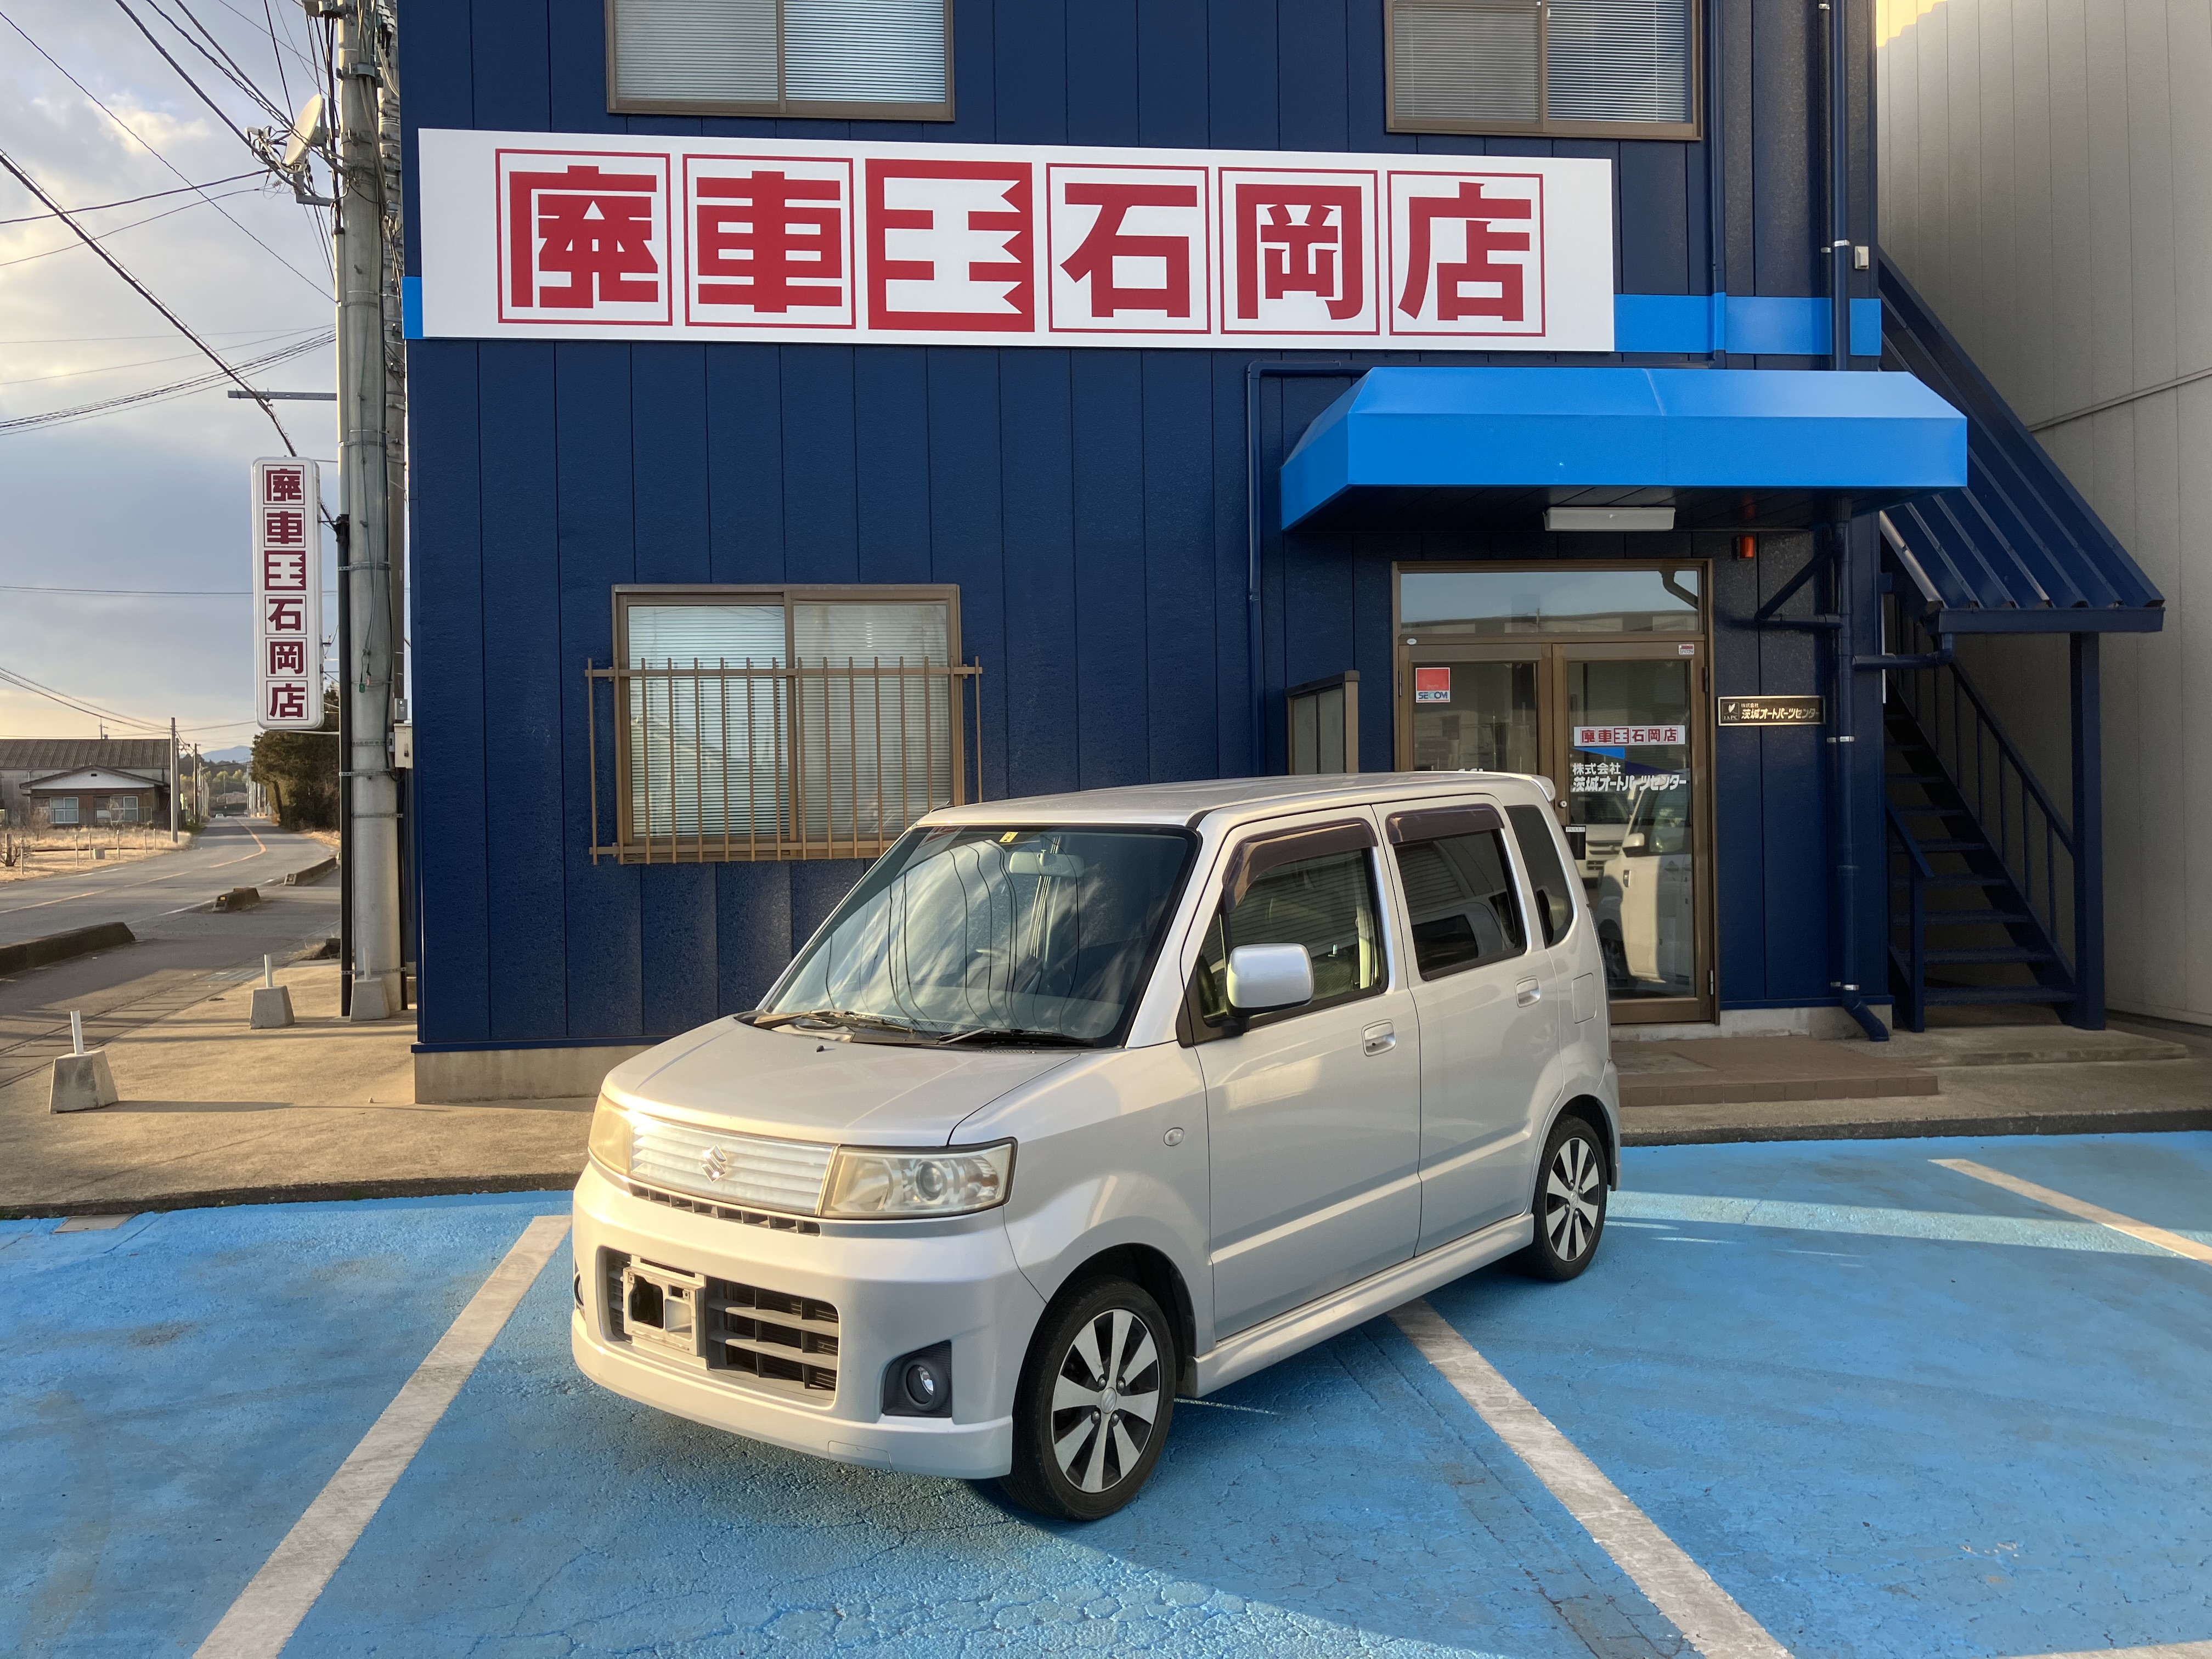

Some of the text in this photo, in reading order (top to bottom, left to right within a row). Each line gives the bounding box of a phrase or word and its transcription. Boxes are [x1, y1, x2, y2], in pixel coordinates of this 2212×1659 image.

[508, 159, 1533, 331] 廃車王石岡店
[265, 467, 307, 719] 廃車王石岡店
[1418, 691, 1448, 699] SECOM
[1741, 708, 1819, 720] 茨城オートパーツセンター
[1581, 727, 1677, 744] 廃車王石岡店
[1572, 763, 1621, 775] 株式会社
[1572, 775, 1686, 792] 茨城オートパーツセンター
